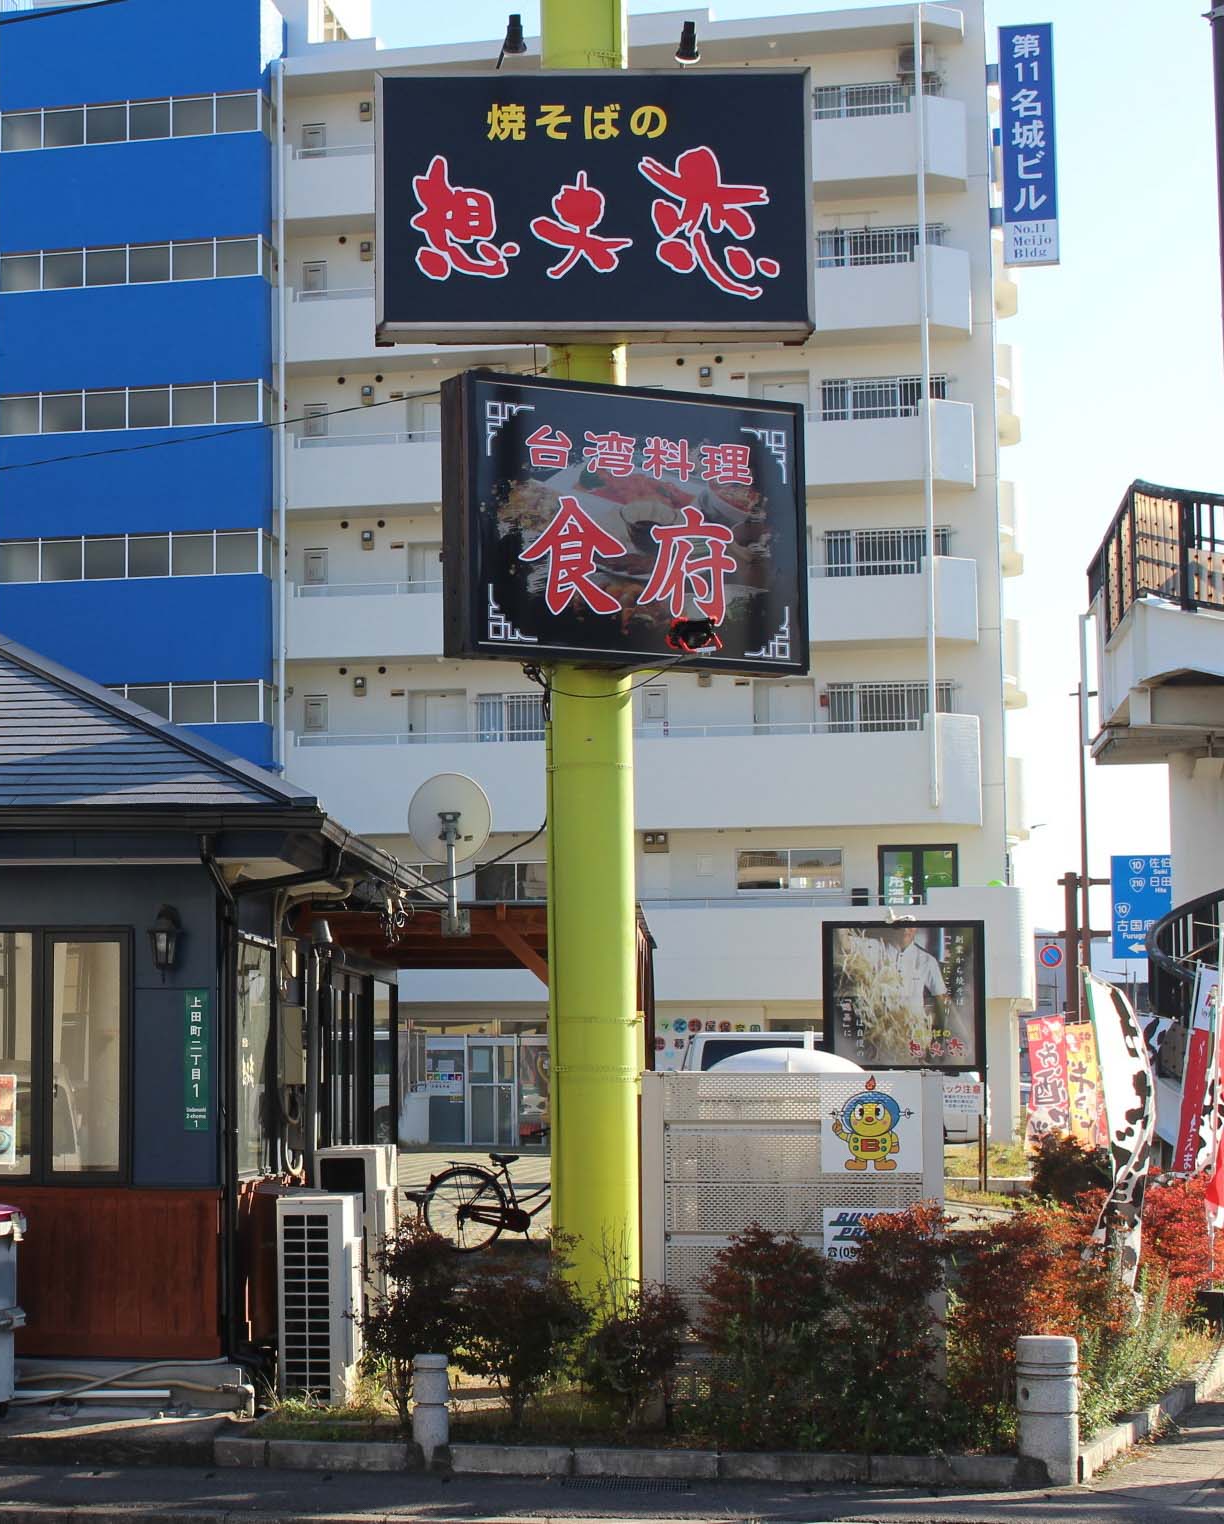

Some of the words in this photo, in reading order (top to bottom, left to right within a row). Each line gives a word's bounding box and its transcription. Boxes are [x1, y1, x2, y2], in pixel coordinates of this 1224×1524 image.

[487, 103, 668, 141] 焼そばの
[1010, 34, 1047, 213] 第11名城ビル
[1013, 223, 1047, 234] No.11
[1013, 235, 1052, 247] Meijo
[1014, 248, 1047, 259] Bldg
[524, 424, 754, 486] 台湾料理
[518, 495, 738, 627] 食府
[1132, 860, 1142, 869] 10
[1150, 876, 1172, 887] 日田
[1117, 904, 1127, 913] 10
[189, 996, 203, 1098] 上田町二丁目1
[193, 1120, 199, 1128] 1
